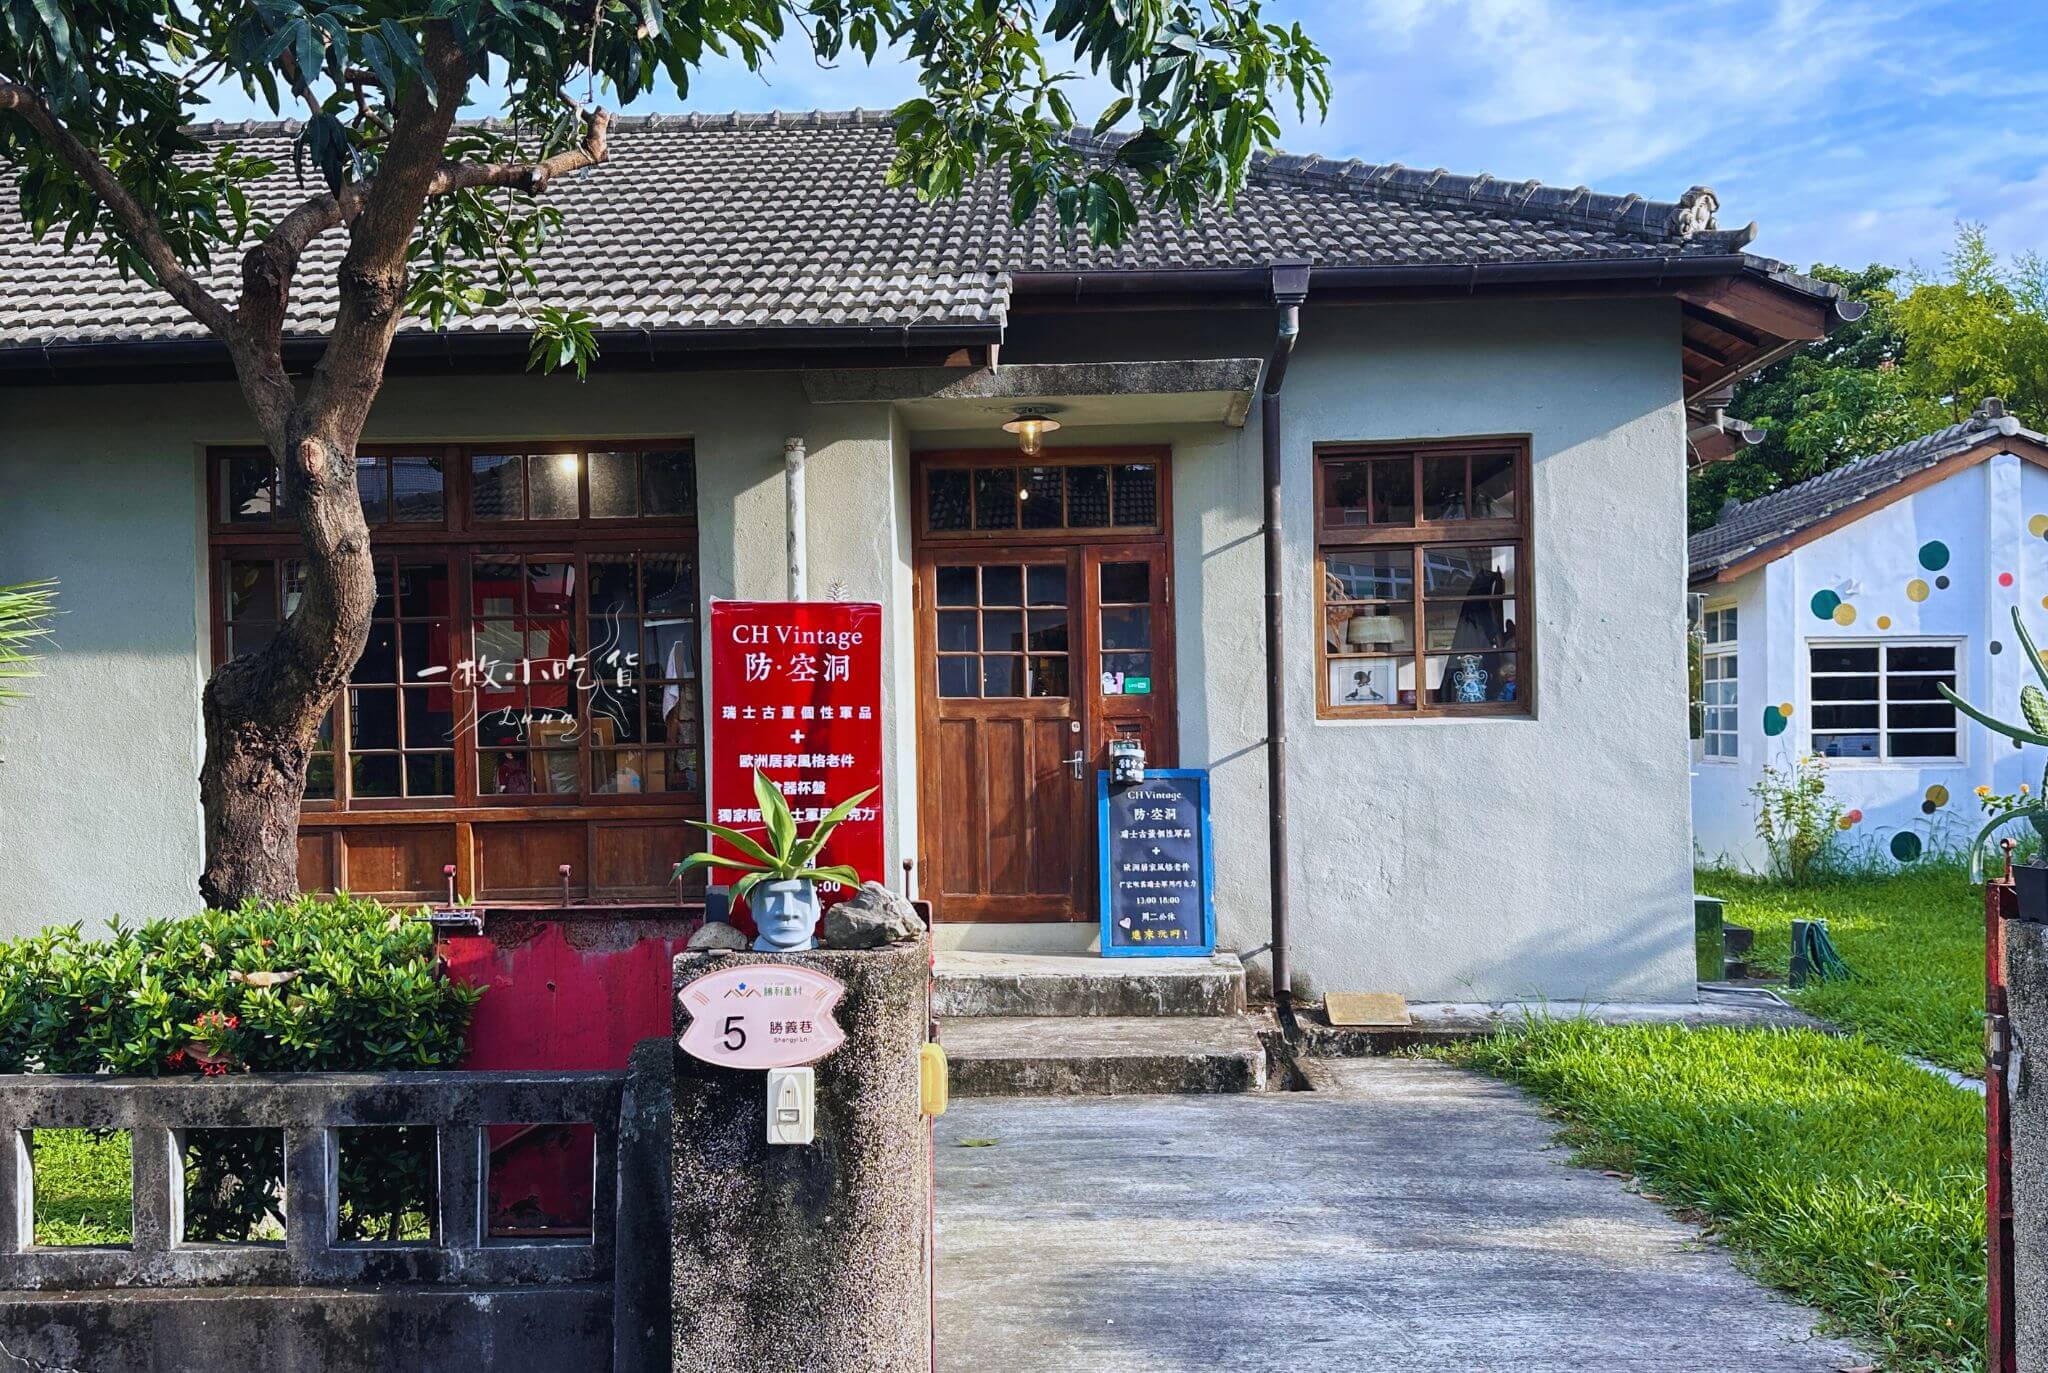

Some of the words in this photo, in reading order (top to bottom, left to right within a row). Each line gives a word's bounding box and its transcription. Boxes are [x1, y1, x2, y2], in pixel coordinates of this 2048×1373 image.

[732, 624, 769, 645] CH
[774, 624, 863, 650] Vintage
[722, 705, 872, 720] 瑞士古董個性軍品
[739, 753, 855, 768] 歐洲居家風格老件
[1144, 790, 1182, 802] Vintage
[723, 1015, 747, 1051] 5
[769, 1020, 814, 1035] 勝義巷
